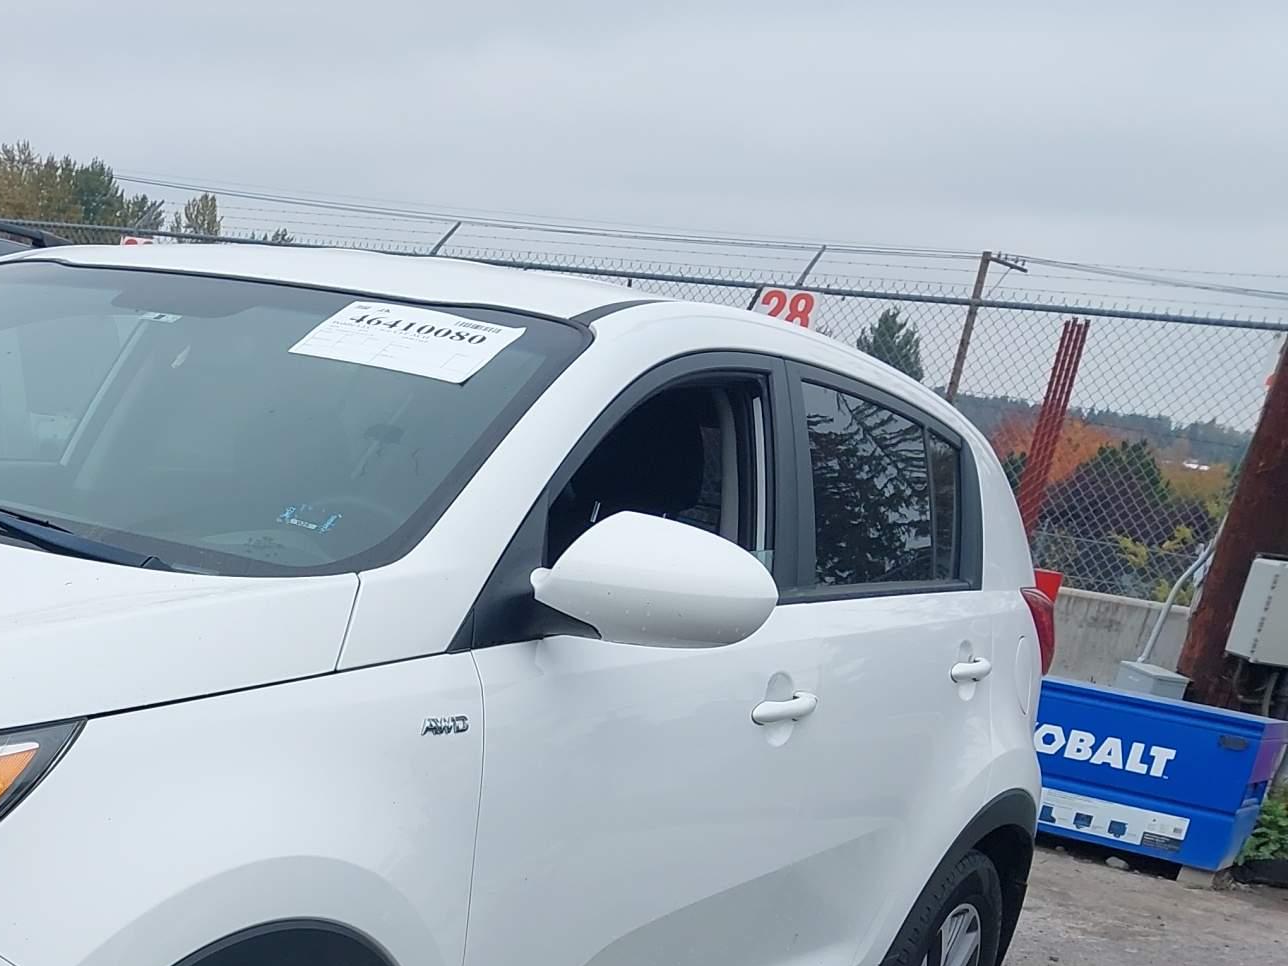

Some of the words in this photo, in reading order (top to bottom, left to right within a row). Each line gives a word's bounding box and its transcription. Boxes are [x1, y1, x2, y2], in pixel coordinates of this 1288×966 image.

[761, 289, 815, 328] 28
[349, 313, 487, 345] 46410080
[421, 715, 469, 736] AWD
[1033, 721, 1176, 778] OBALT
